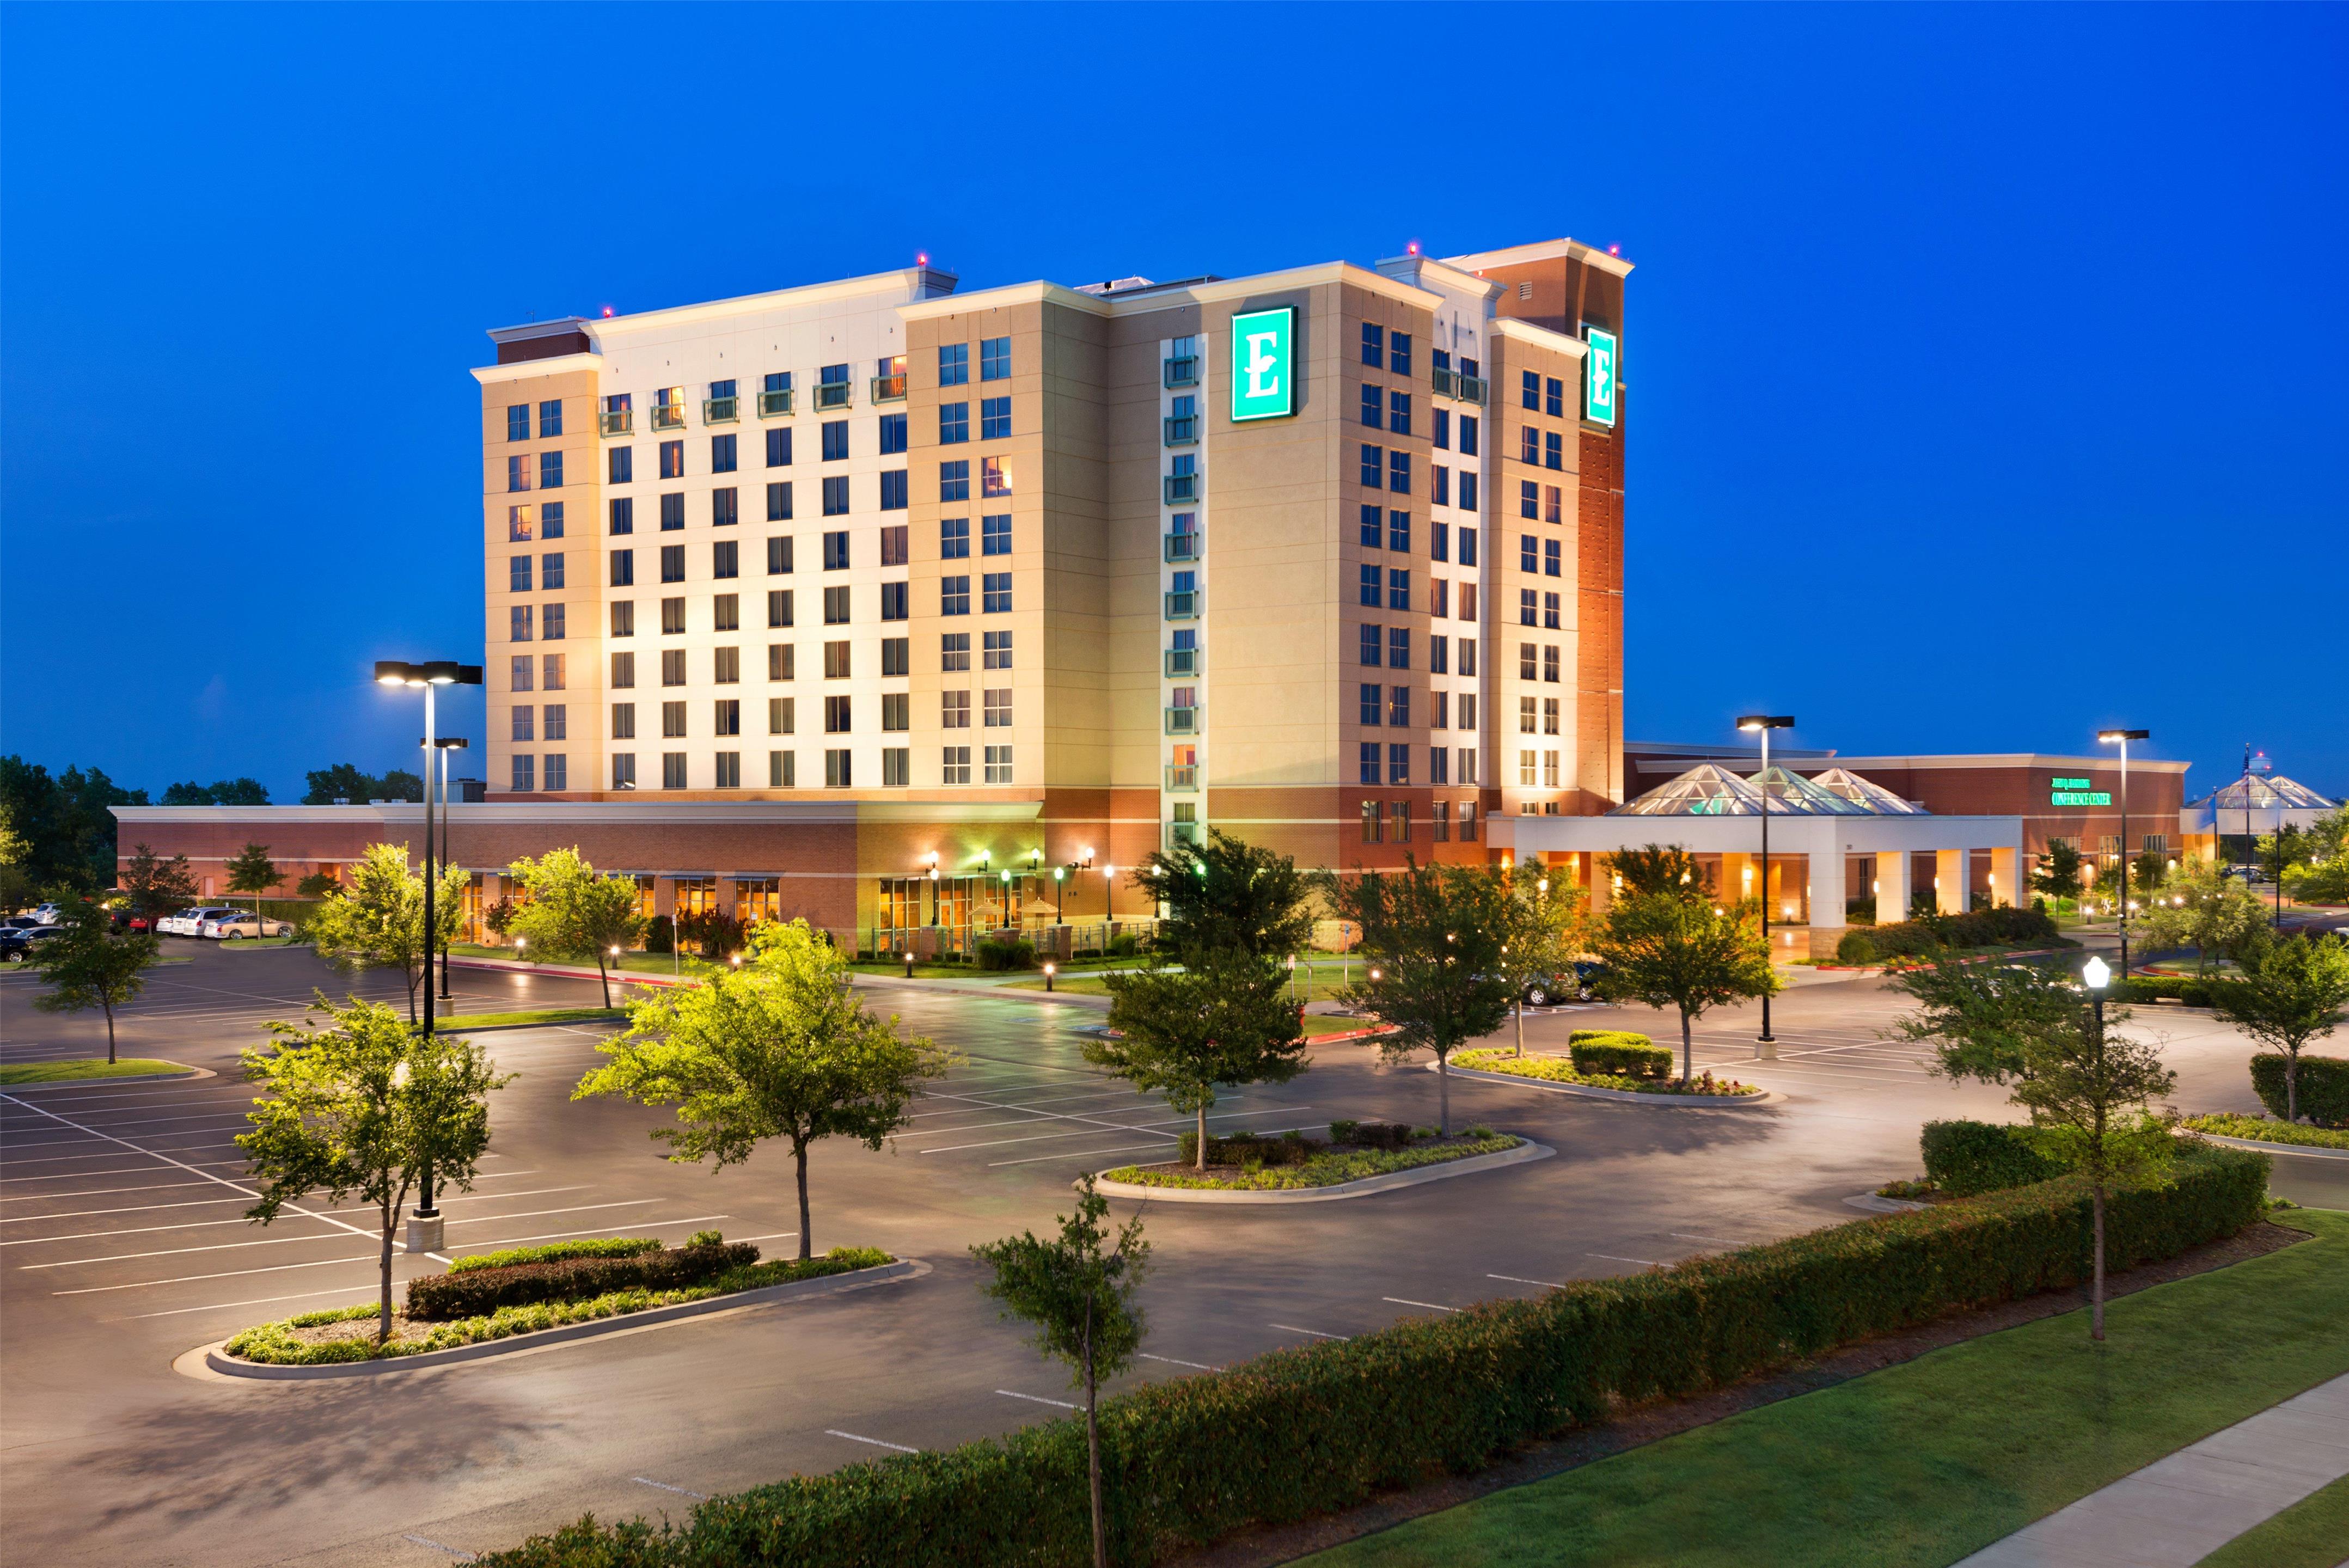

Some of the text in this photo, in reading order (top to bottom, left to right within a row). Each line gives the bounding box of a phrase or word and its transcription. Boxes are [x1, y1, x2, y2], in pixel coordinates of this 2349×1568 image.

[1244, 331, 1279, 398] E
[1593, 348, 1610, 407] E
[2052, 792, 2112, 806] CONFERENCE CENTER
